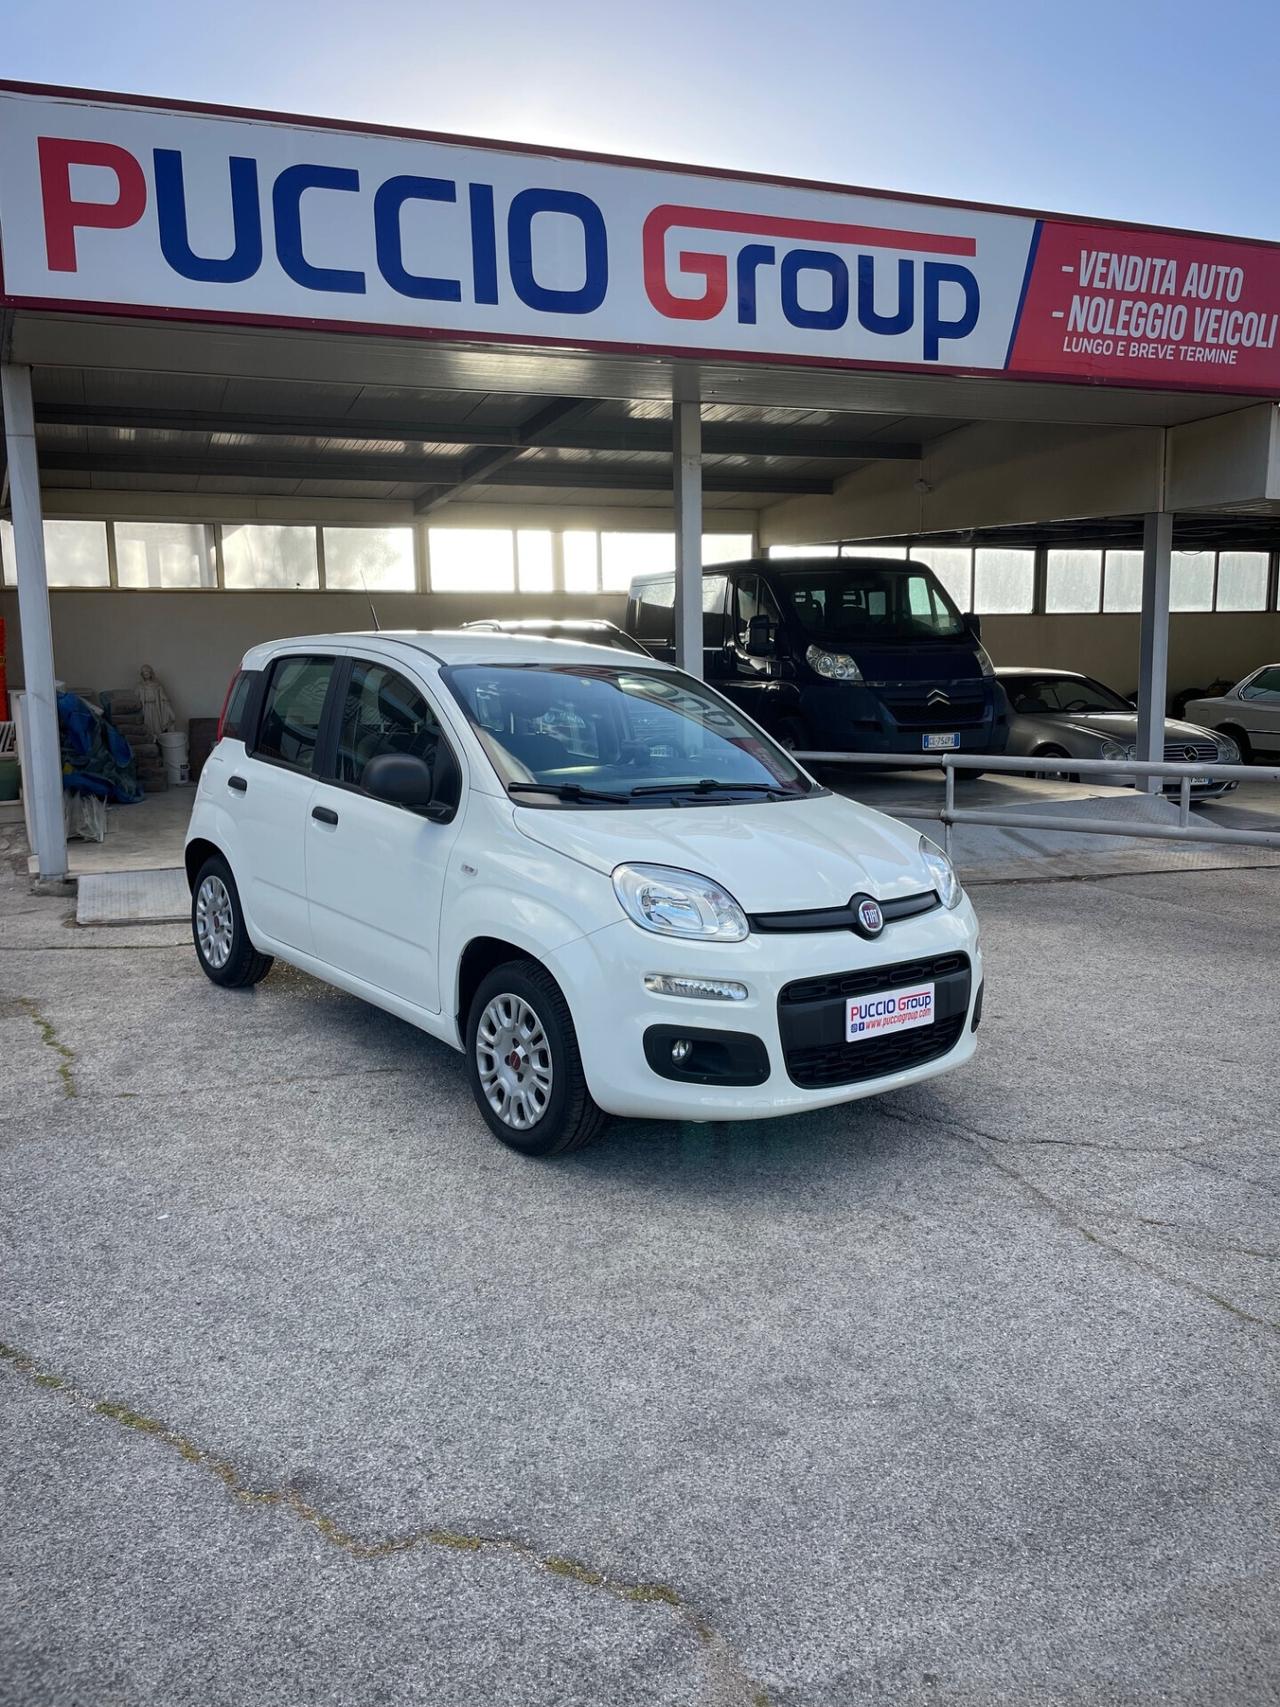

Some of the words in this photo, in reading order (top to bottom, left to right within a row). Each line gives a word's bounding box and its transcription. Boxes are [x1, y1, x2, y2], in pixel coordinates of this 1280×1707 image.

[37, 136, 609, 314] PUCCIO
[1078, 249, 1177, 296] VENDITA
[1181, 262, 1244, 303] AUTO
[1066, 294, 1188, 342] NOLEGGIO
[1193, 306, 1279, 349] VEICOLI
[1062, 336, 1114, 356] LUNGO
[1116, 341, 1127, 357] E
[1128, 342, 1176, 361] BREVE
[1178, 345, 1239, 365] TERMINE
[864, 909, 878, 923] FIAT
[850, 998, 896, 1022] PUCCIO
[865, 1007, 932, 1029] www.pucciogroup.com
